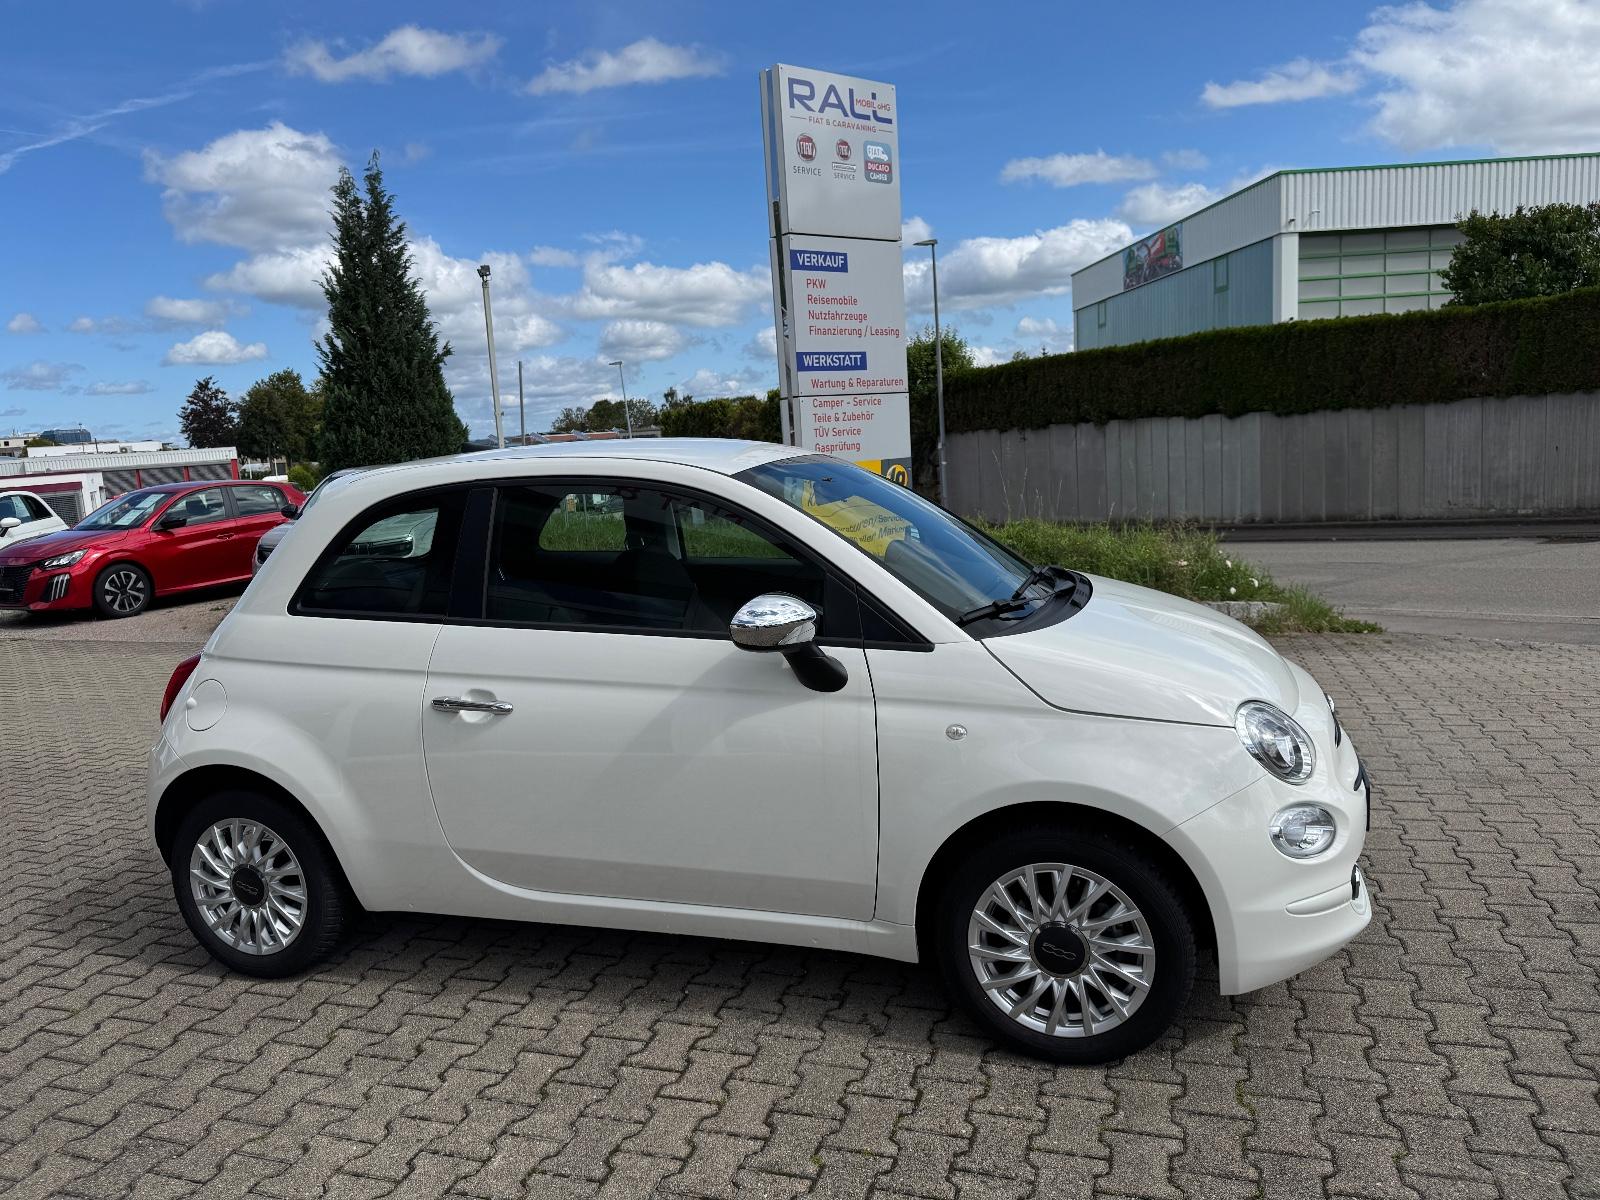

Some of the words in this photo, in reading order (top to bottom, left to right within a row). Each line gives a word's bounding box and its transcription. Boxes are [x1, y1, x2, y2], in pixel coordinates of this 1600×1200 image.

[788, 77, 892, 124] RALL
[856, 98, 876, 109] MOBIL
[809, 116, 823, 125] FIAT
[833, 120, 876, 132] CARAVANING
[800, 141, 812, 156] FIAT
[793, 166, 822, 176] SERVICE
[868, 163, 889, 172] DUCATO
[834, 172, 856, 180] SERVICE
[797, 253, 844, 267] VERKAUF
[806, 278, 826, 288] PKW
[807, 294, 858, 306] Reisemobile
[808, 310, 868, 323] Nutzfahrzeuge
[809, 326, 862, 338] Finanzierung
[870, 326, 900, 338] Leasing
[803, 355, 862, 366] WERKSTATT
[811, 378, 845, 390] Wartung
[848, 378, 854, 387] &
[857, 378, 904, 389] Reparaturen
[813, 398, 844, 409] Camper
[853, 397, 881, 406] Service
[813, 413, 832, 423] Teile
[834, 413, 840, 422] &
[842, 411, 874, 422] Zubehör
[814, 426, 829, 437] TÜV
[832, 427, 861, 436] Service
[815, 442, 861, 454] Gasprüfung
